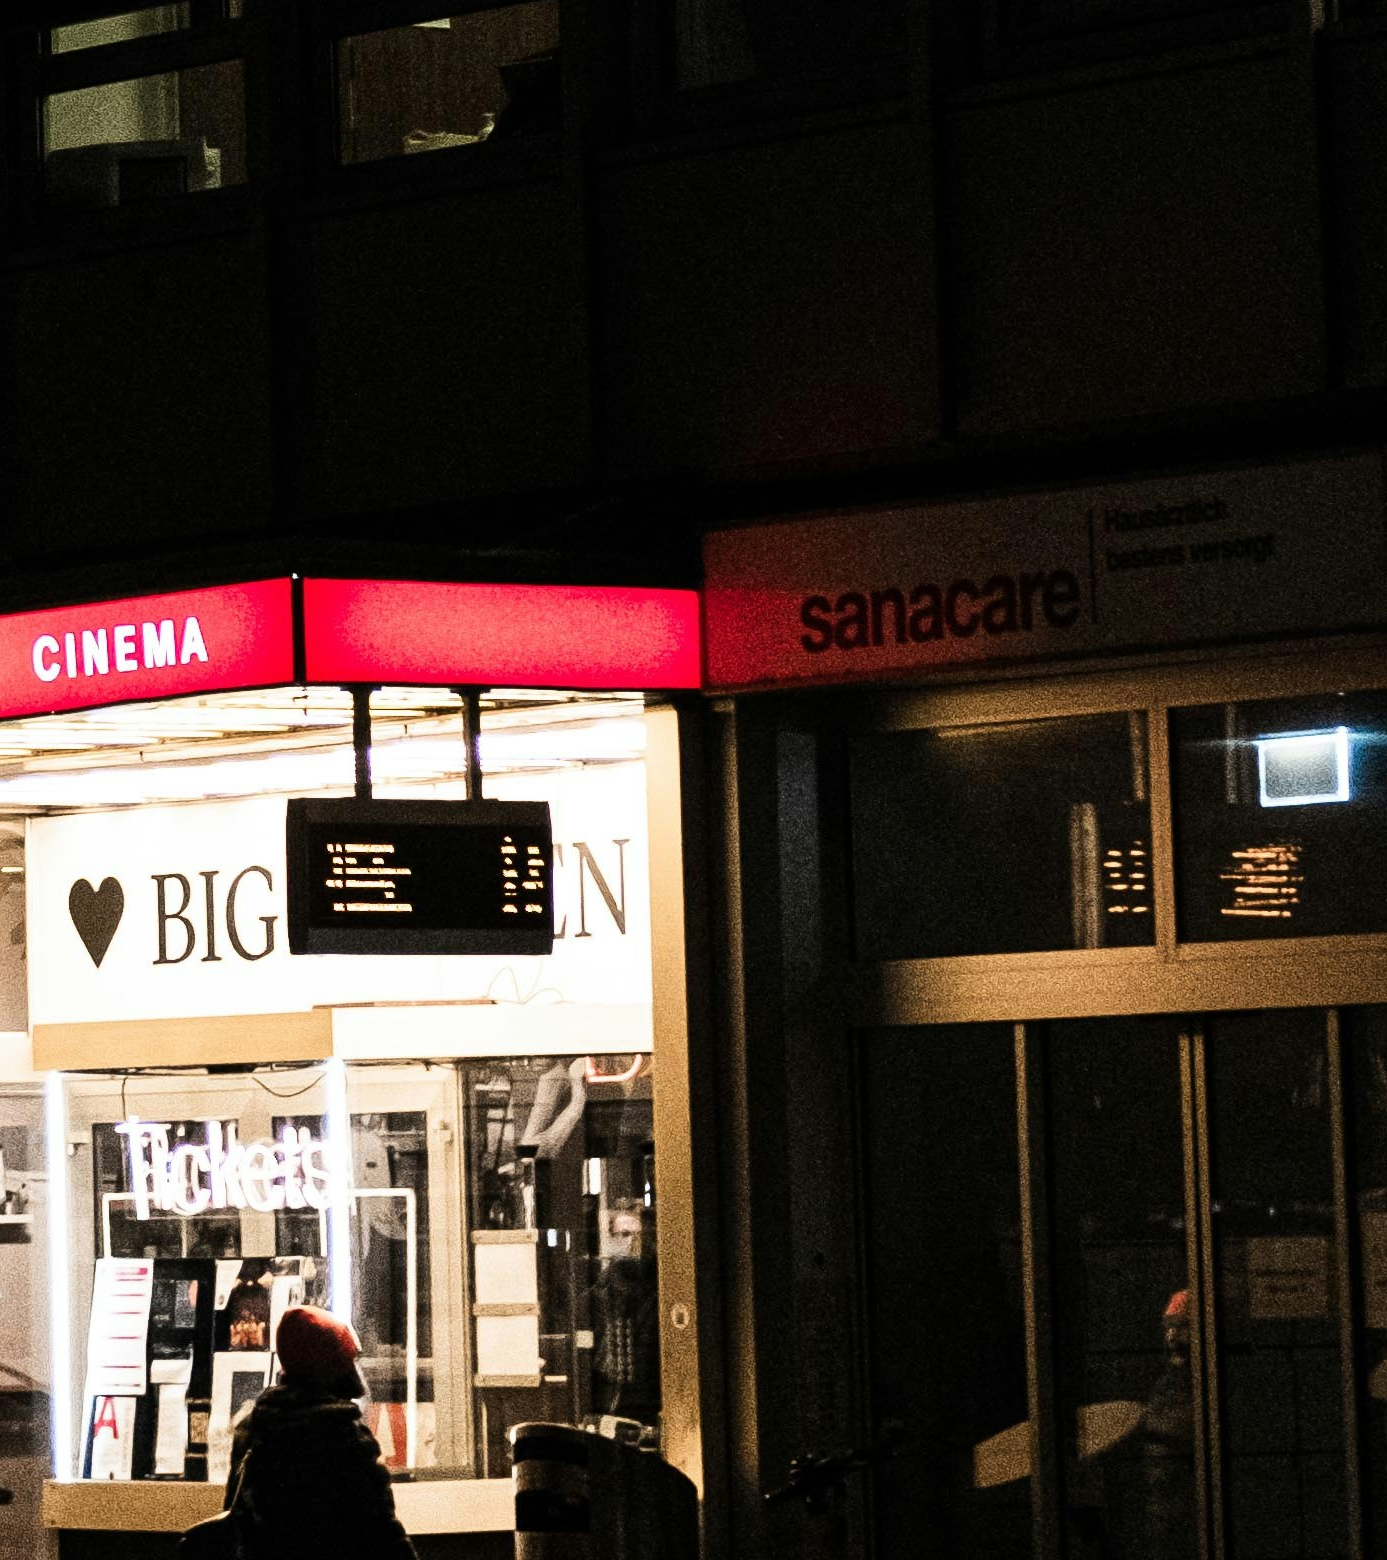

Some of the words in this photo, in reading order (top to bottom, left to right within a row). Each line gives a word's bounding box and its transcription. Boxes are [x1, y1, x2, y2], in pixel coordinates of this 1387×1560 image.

[31, 616, 209, 683] CINEMA
[800, 566, 1081, 654] sanacare
[151, 866, 277, 966] BIG
[115, 1116, 337, 1221] Tickets
